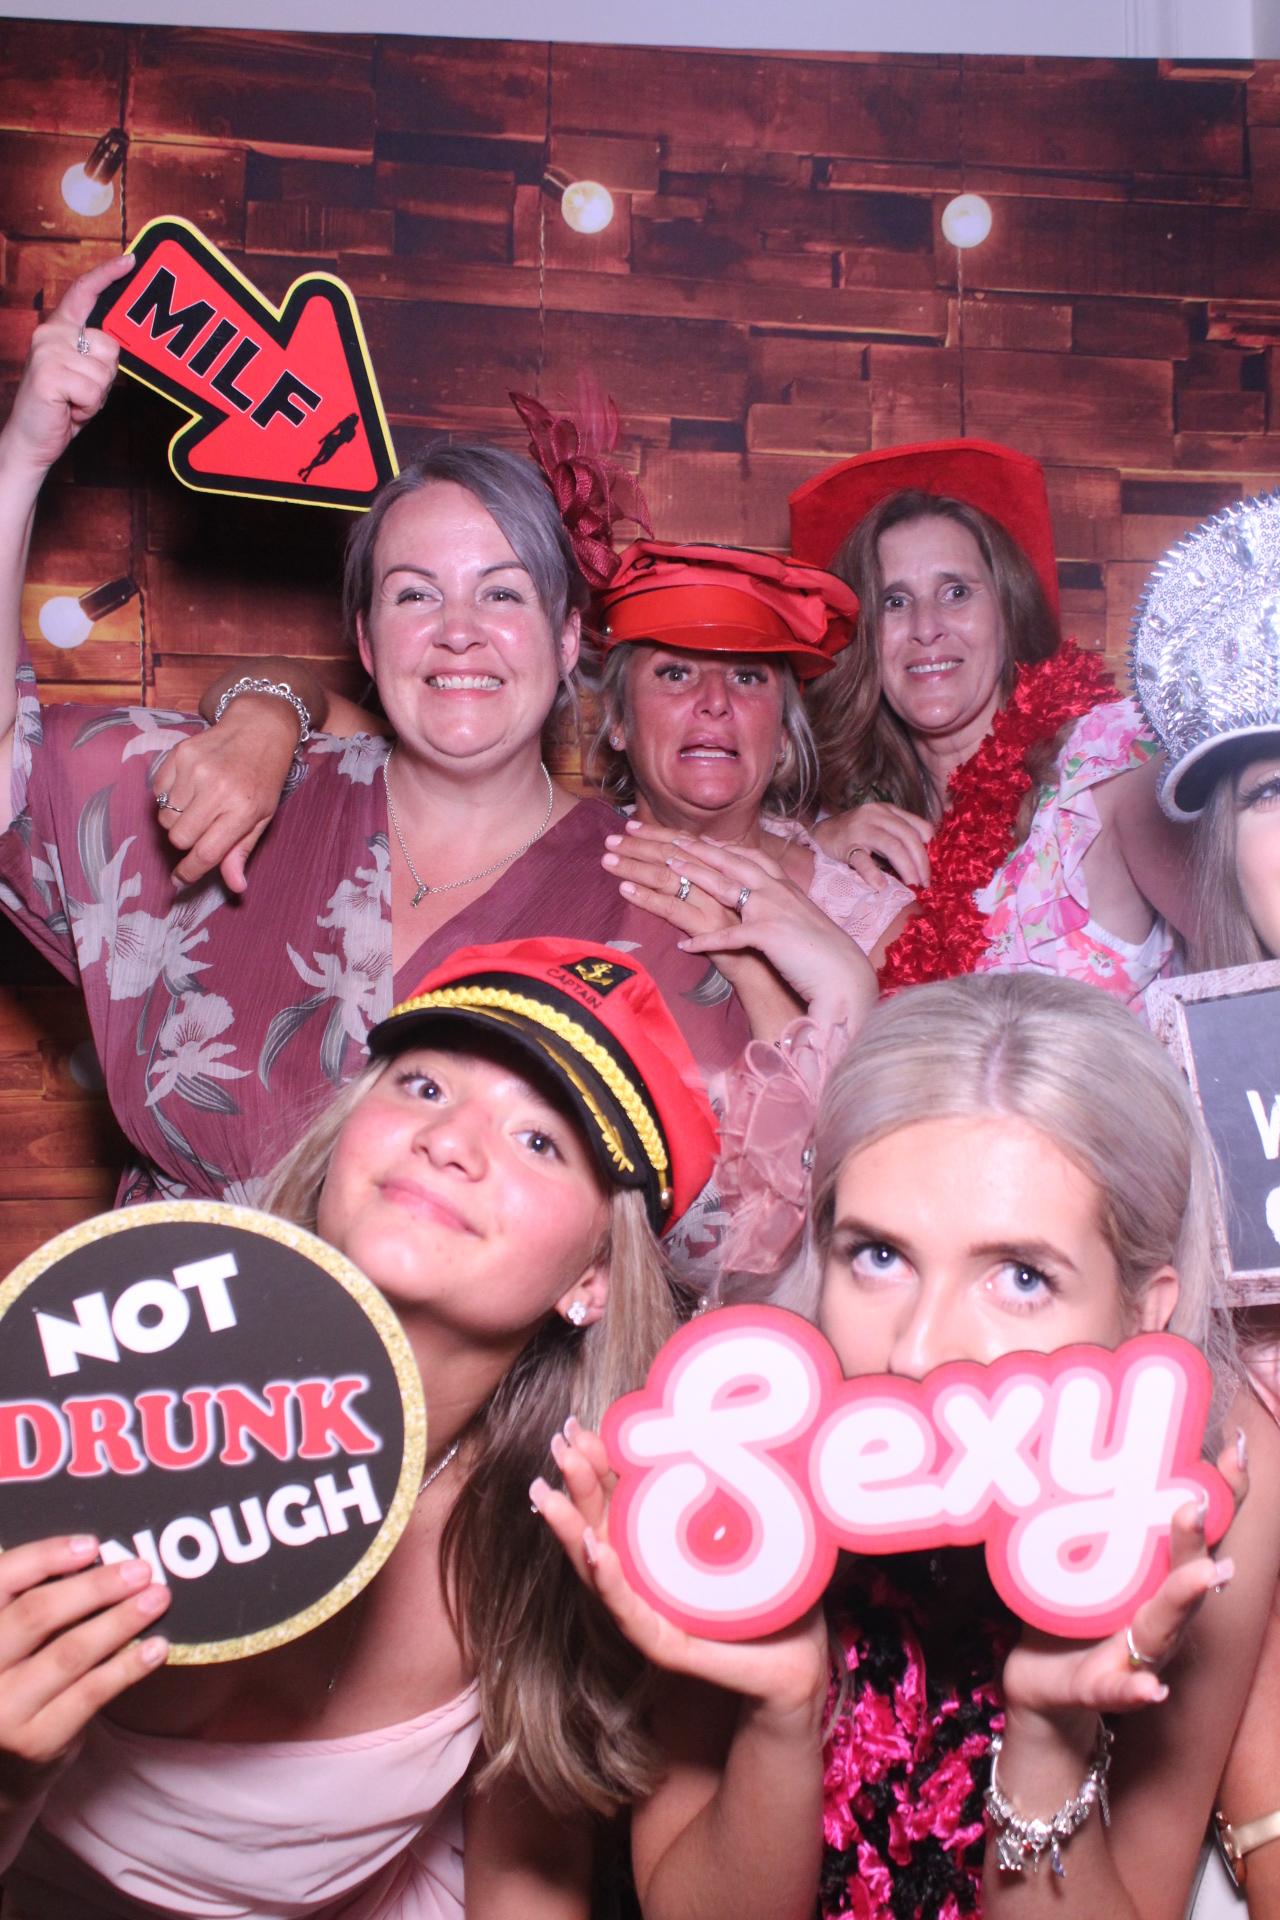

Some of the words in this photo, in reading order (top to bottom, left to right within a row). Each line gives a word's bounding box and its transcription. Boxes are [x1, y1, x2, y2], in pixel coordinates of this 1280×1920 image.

[125, 265, 323, 430] MILF
[546, 967, 602, 1010] CAPTAIN
[36, 1252, 239, 1377] NOT
[0, 1374, 382, 1482] DRUNK
[620, 1324, 1208, 1616] Sexy
[99, 1463, 383, 1585] NOUGH
